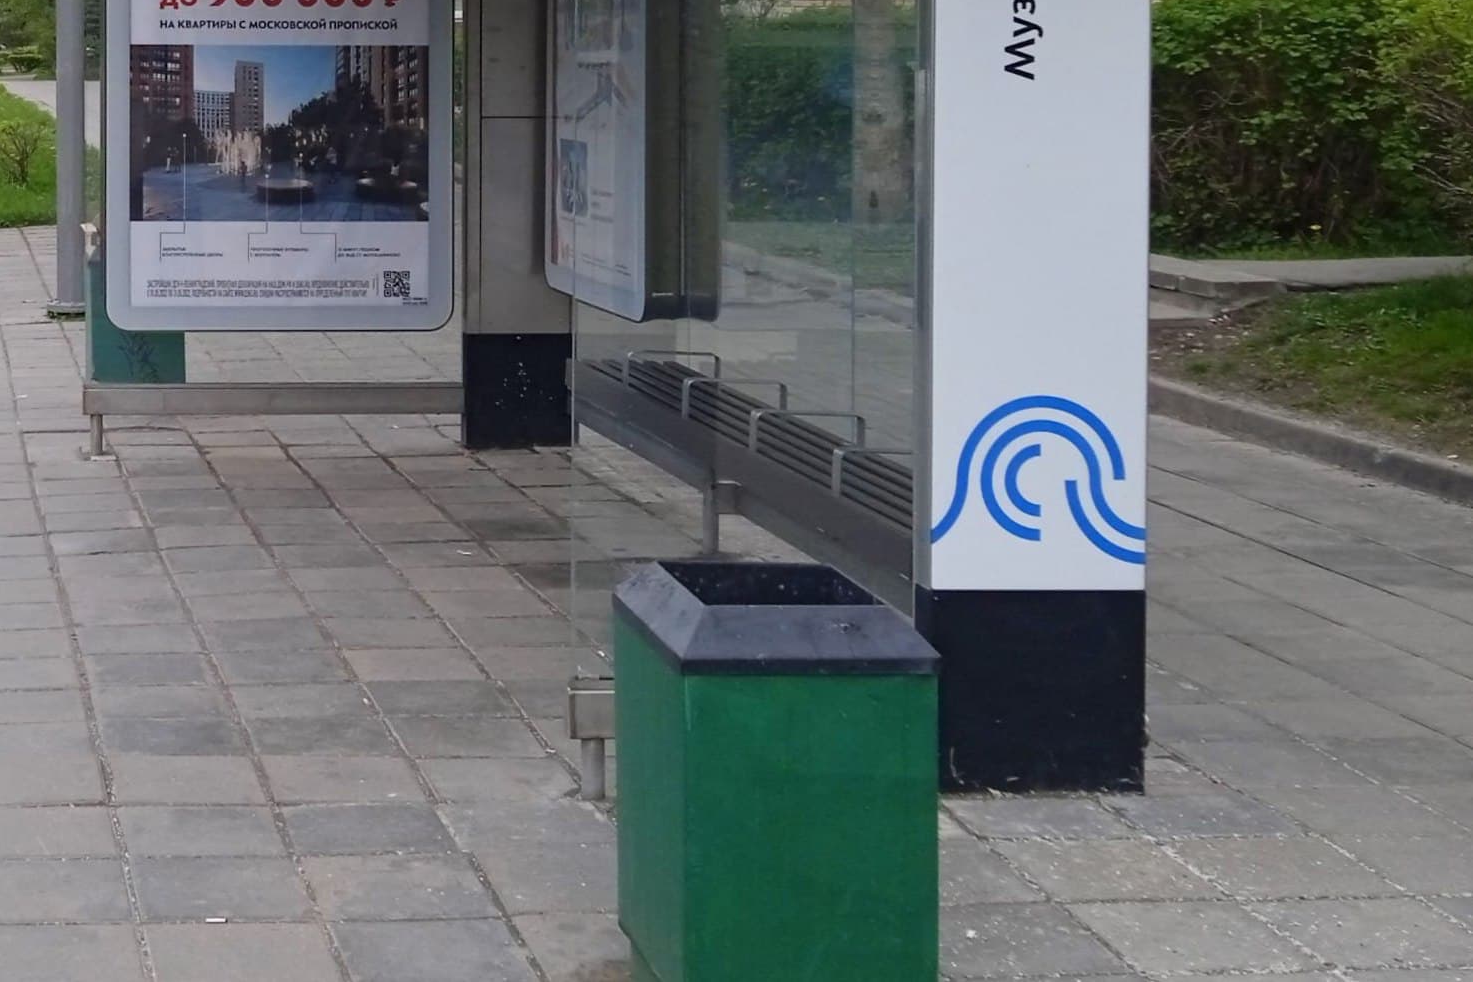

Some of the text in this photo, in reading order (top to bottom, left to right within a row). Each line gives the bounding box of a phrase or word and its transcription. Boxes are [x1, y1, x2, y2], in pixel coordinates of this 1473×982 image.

[159, 17, 398, 31] НА КВАРТИРЫ С МОСКОВСКОЙ ПРОПИСКОЙ
